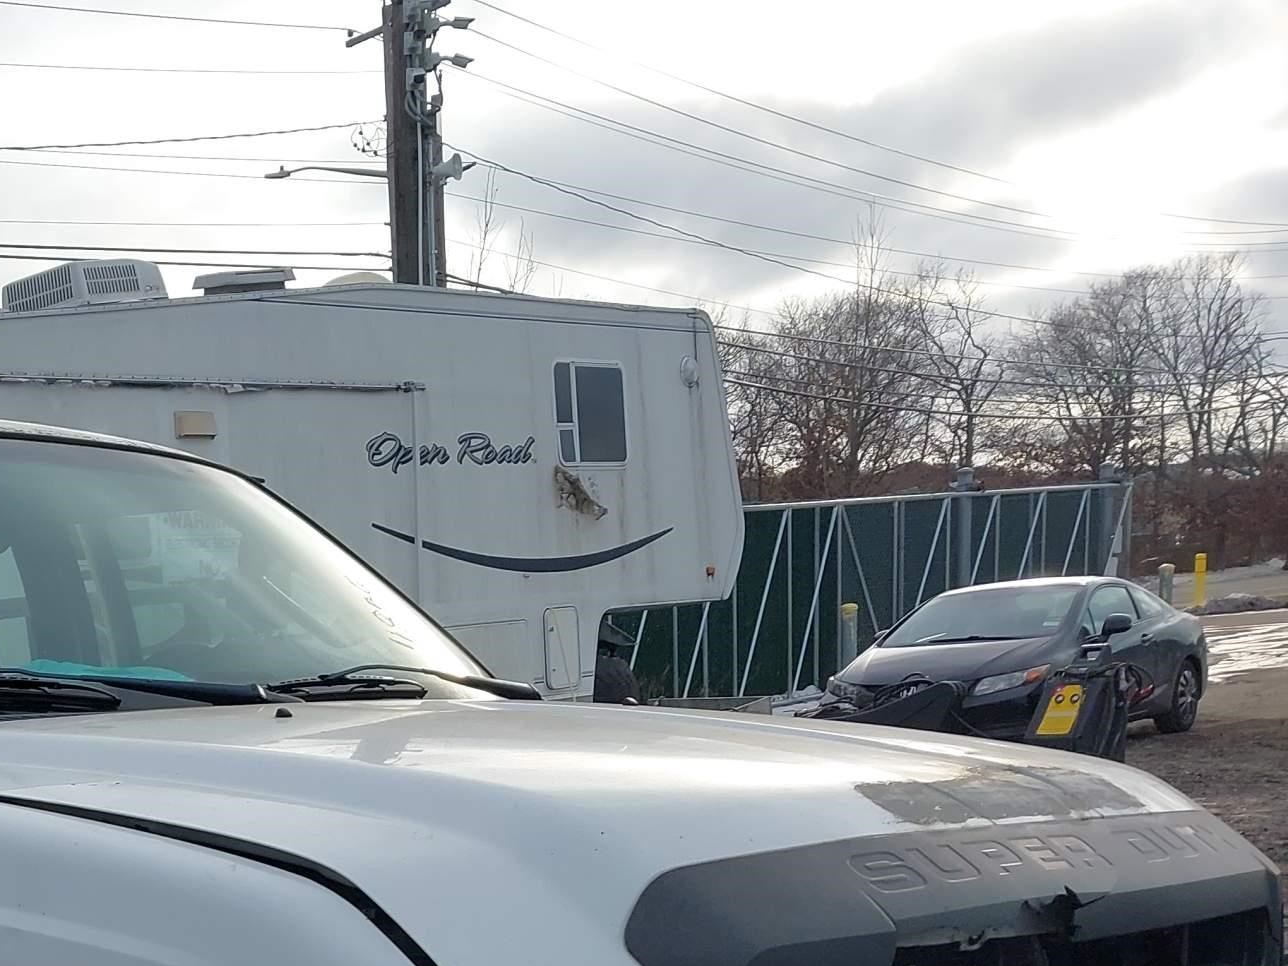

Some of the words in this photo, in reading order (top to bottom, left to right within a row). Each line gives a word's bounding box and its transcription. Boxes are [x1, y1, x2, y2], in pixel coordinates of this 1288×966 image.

[366, 431, 450, 474] Open
[457, 432, 535, 465] Road
[846, 836, 1114, 893] SUPER
